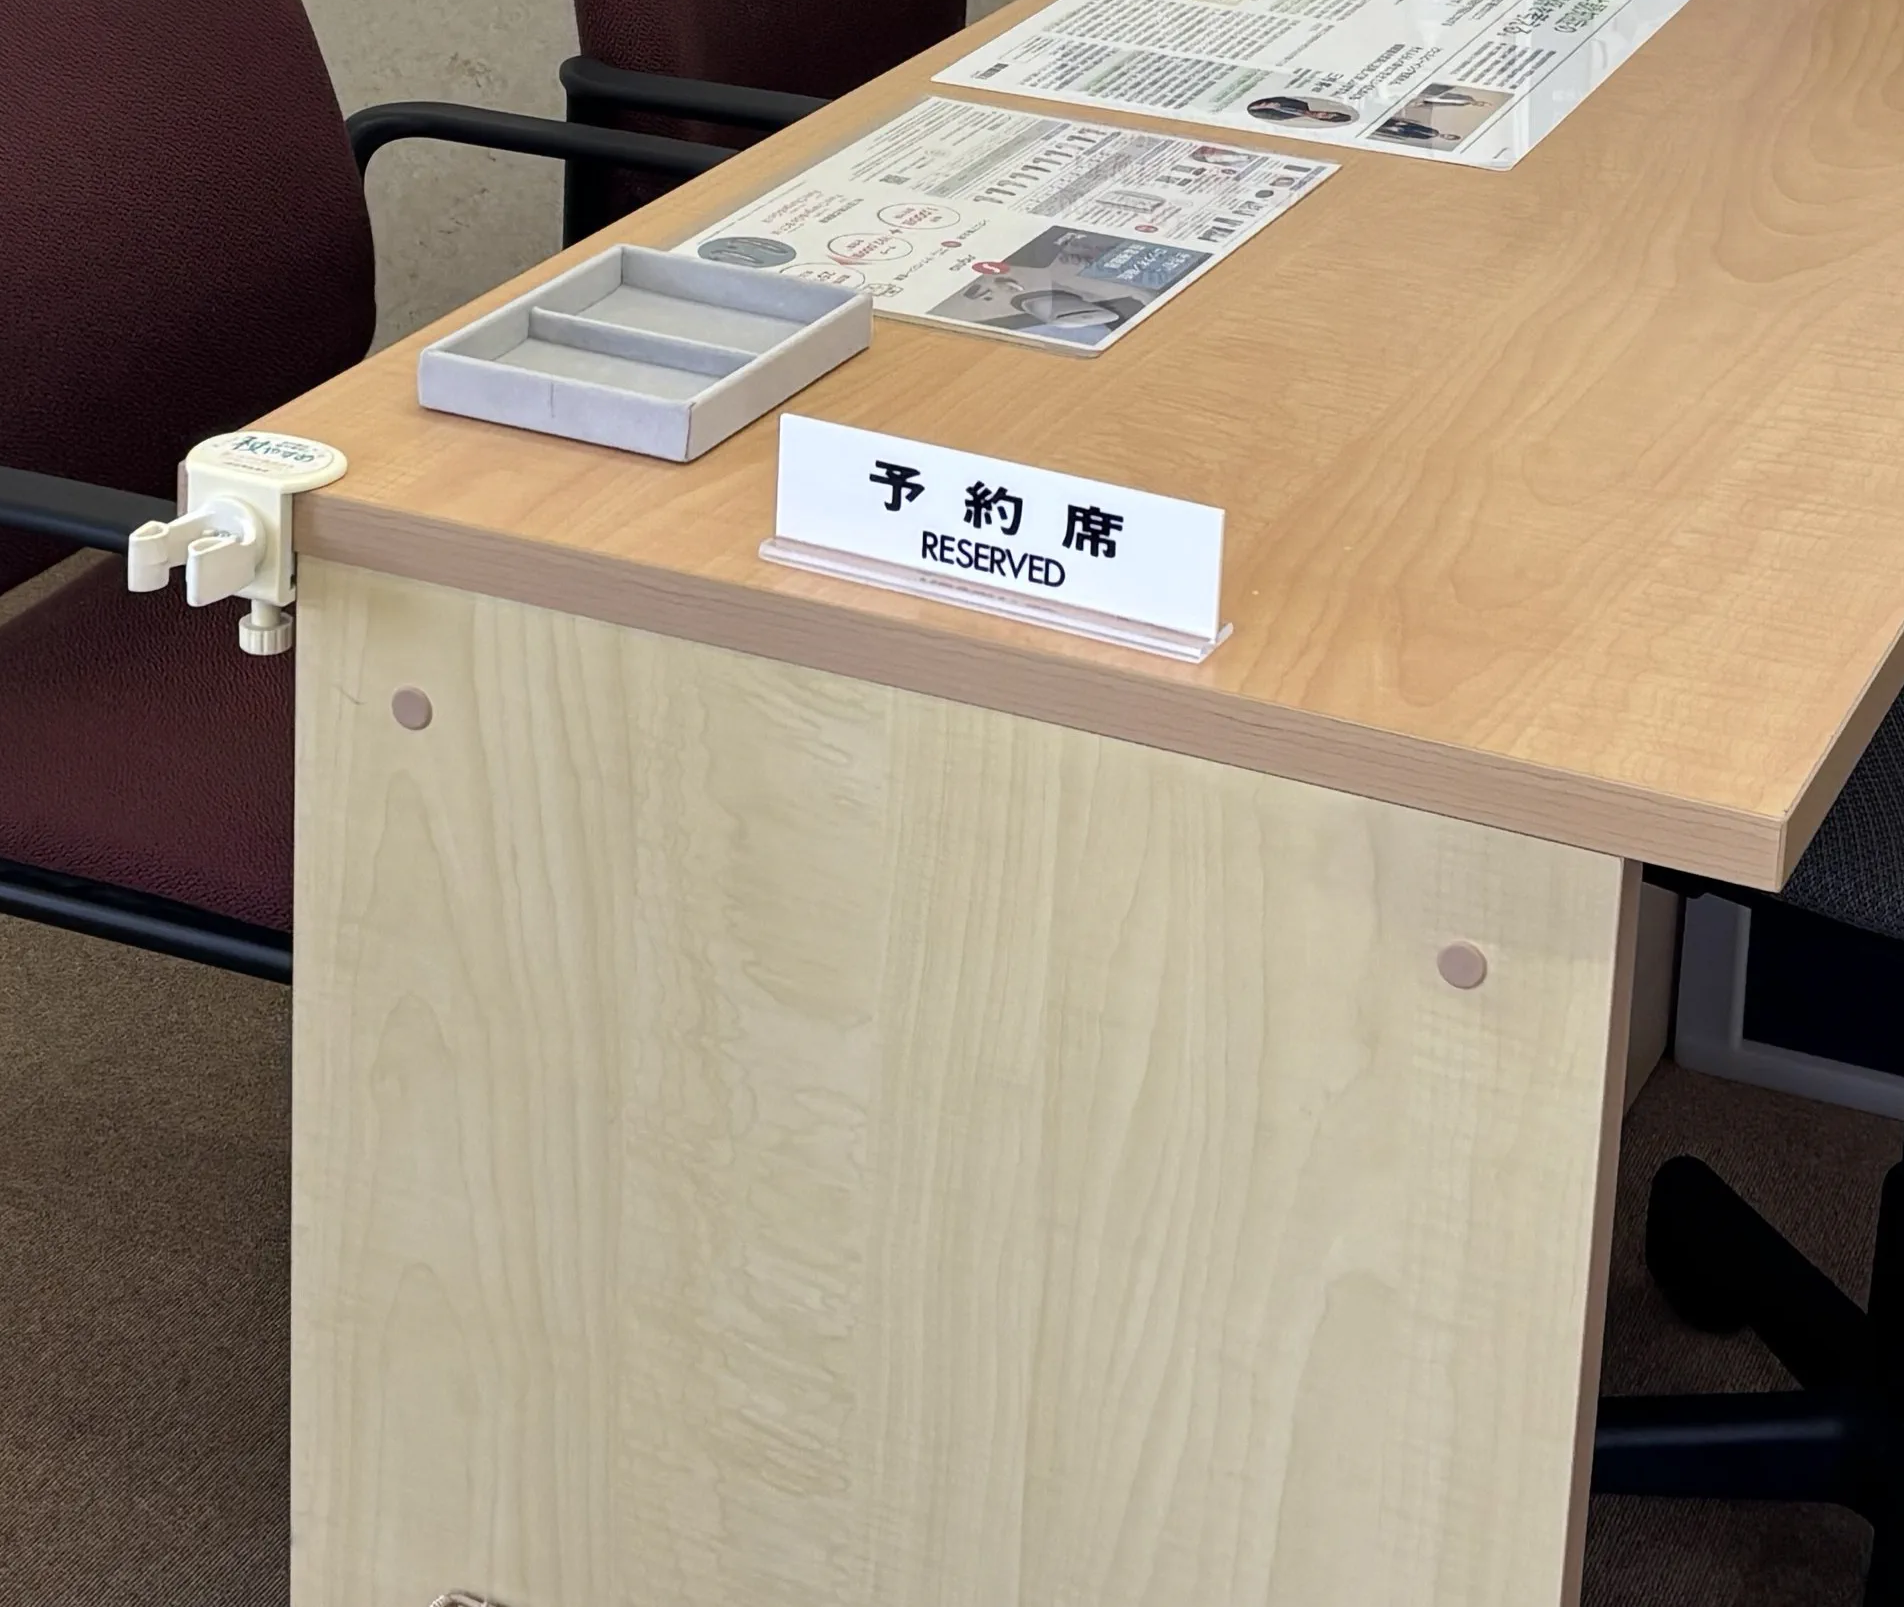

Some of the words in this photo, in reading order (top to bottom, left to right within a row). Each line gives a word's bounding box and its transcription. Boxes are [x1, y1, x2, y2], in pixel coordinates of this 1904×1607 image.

[867, 459, 1126, 560] 予約席
[920, 527, 1067, 591] RESERVED
